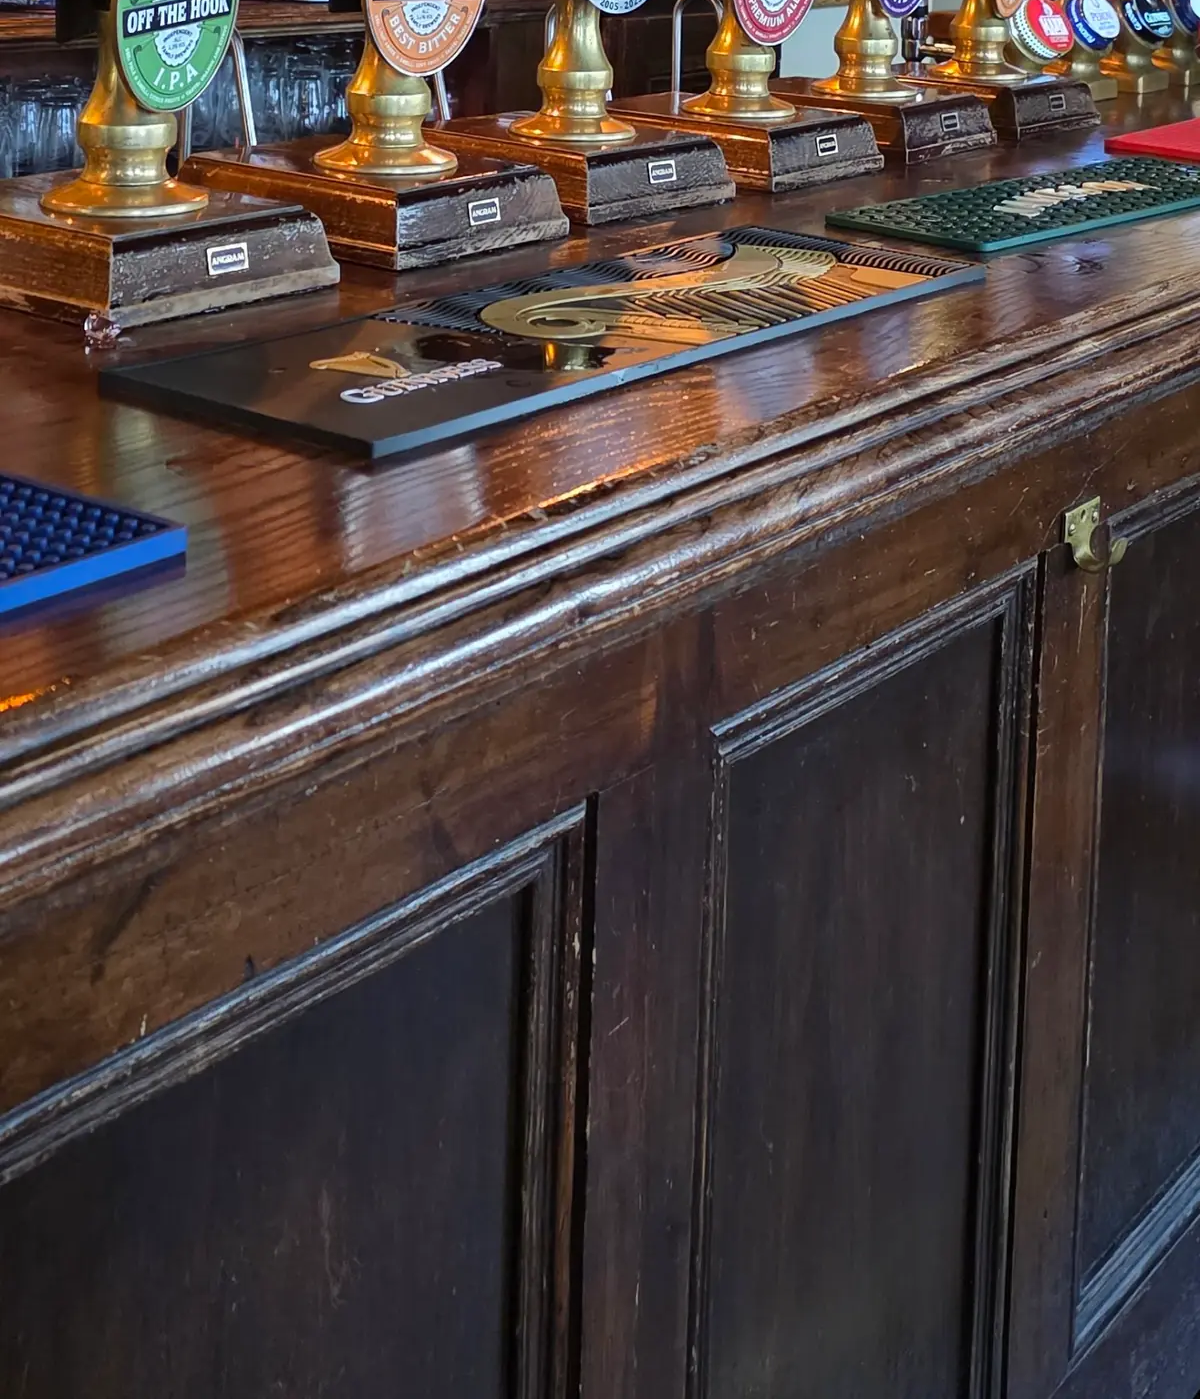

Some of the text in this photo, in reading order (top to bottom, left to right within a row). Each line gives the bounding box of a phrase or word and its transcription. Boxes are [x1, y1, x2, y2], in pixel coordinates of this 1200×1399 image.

[127, 8, 154, 34] OFF
[158, 1, 187, 26] THE
[389, 13, 461, 54] BEST BITTER
[211, 251, 245, 266] ANGRAM
